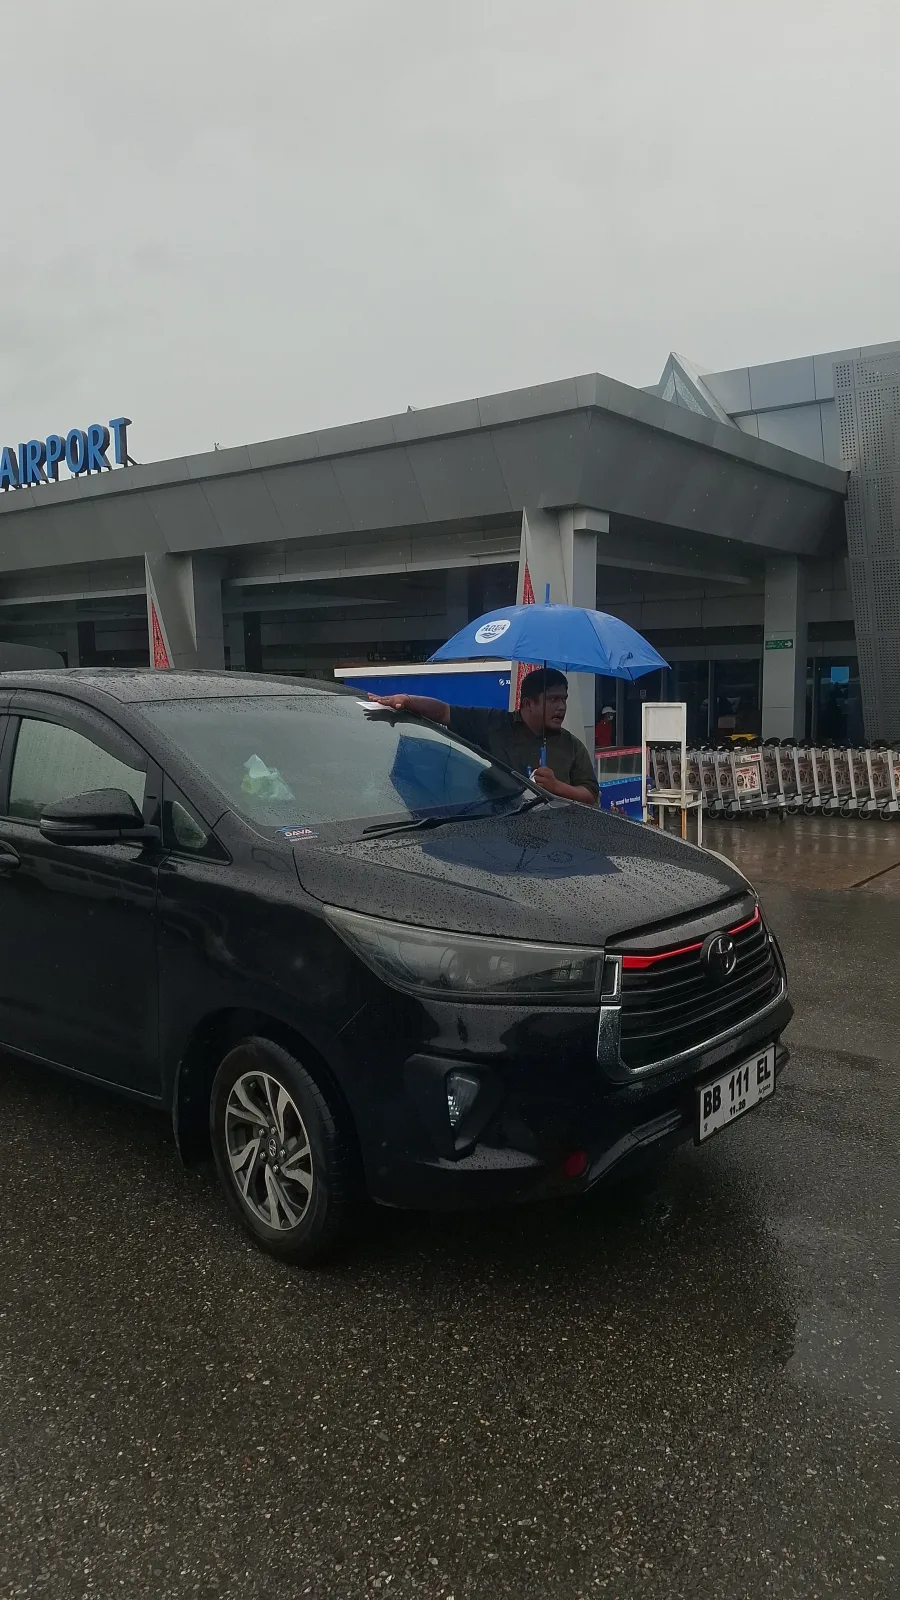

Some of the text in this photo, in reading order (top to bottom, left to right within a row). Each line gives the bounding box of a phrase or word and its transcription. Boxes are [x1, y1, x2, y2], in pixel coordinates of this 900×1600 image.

[0, 417, 130, 488] AIRPORT
[703, 1055, 771, 1120] BB 111 EL
